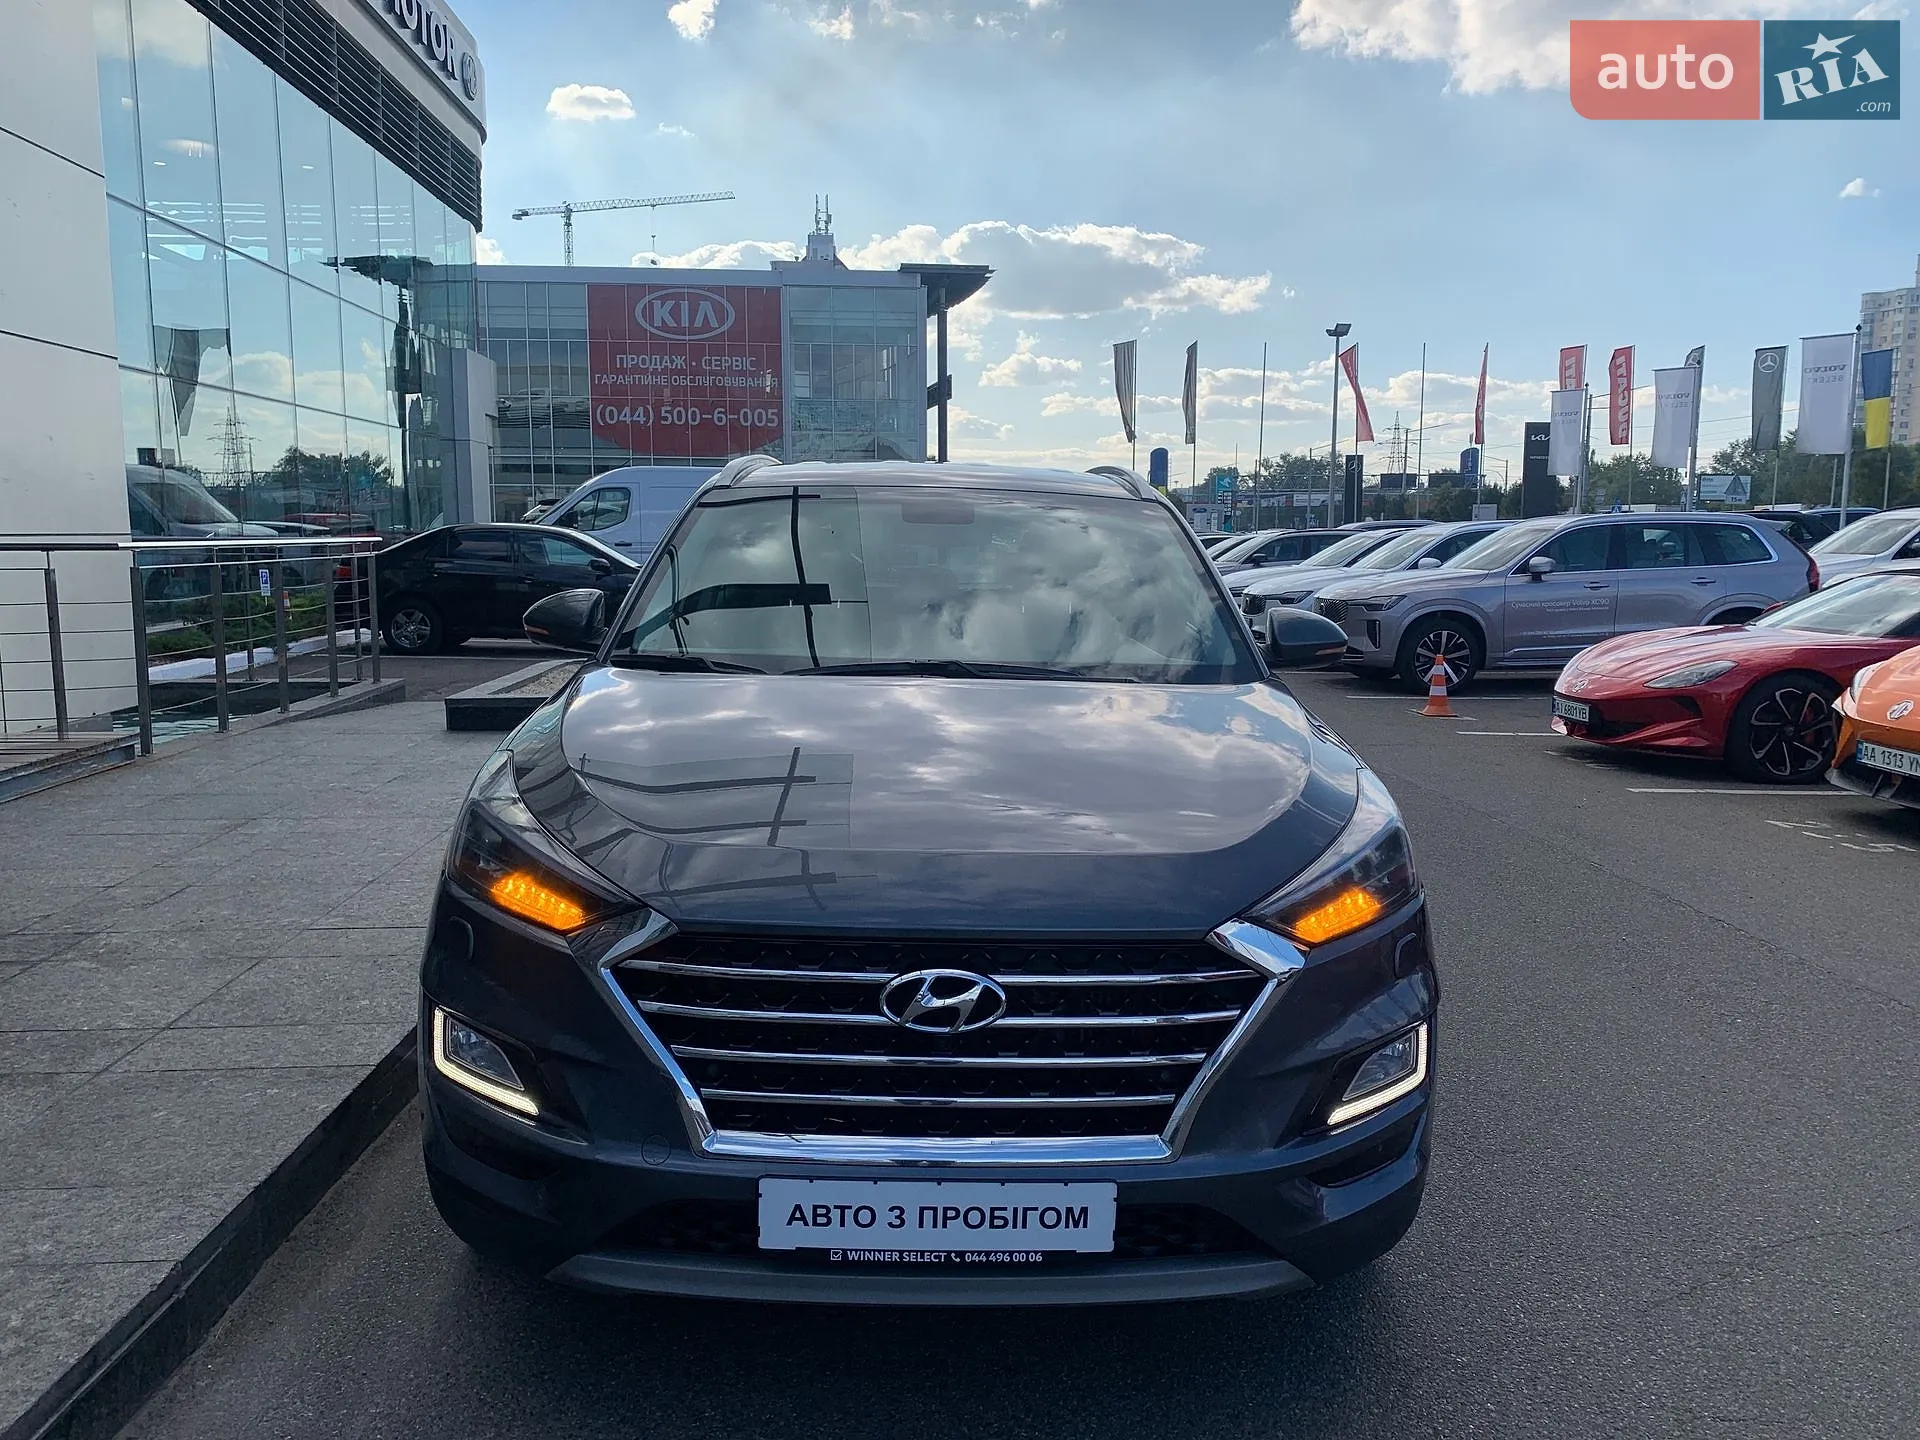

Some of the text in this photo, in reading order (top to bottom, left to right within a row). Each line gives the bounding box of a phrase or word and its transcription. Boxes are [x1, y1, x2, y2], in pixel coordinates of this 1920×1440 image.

[651, 300, 719, 328] KIA
[616, 354, 757, 372] ПРОДАЖ СЕРВІС
[596, 404, 779, 427] (044) 500-6-005
[1863, 745, 1876, 762] AA
[1881, 750, 1904, 769] 1313
[785, 1202, 878, 1229] АВТО
[917, 1205, 1090, 1230] ПРОБІГОМ
[847, 1250, 1043, 1263] WINNER SELECT 044 496 00 06
